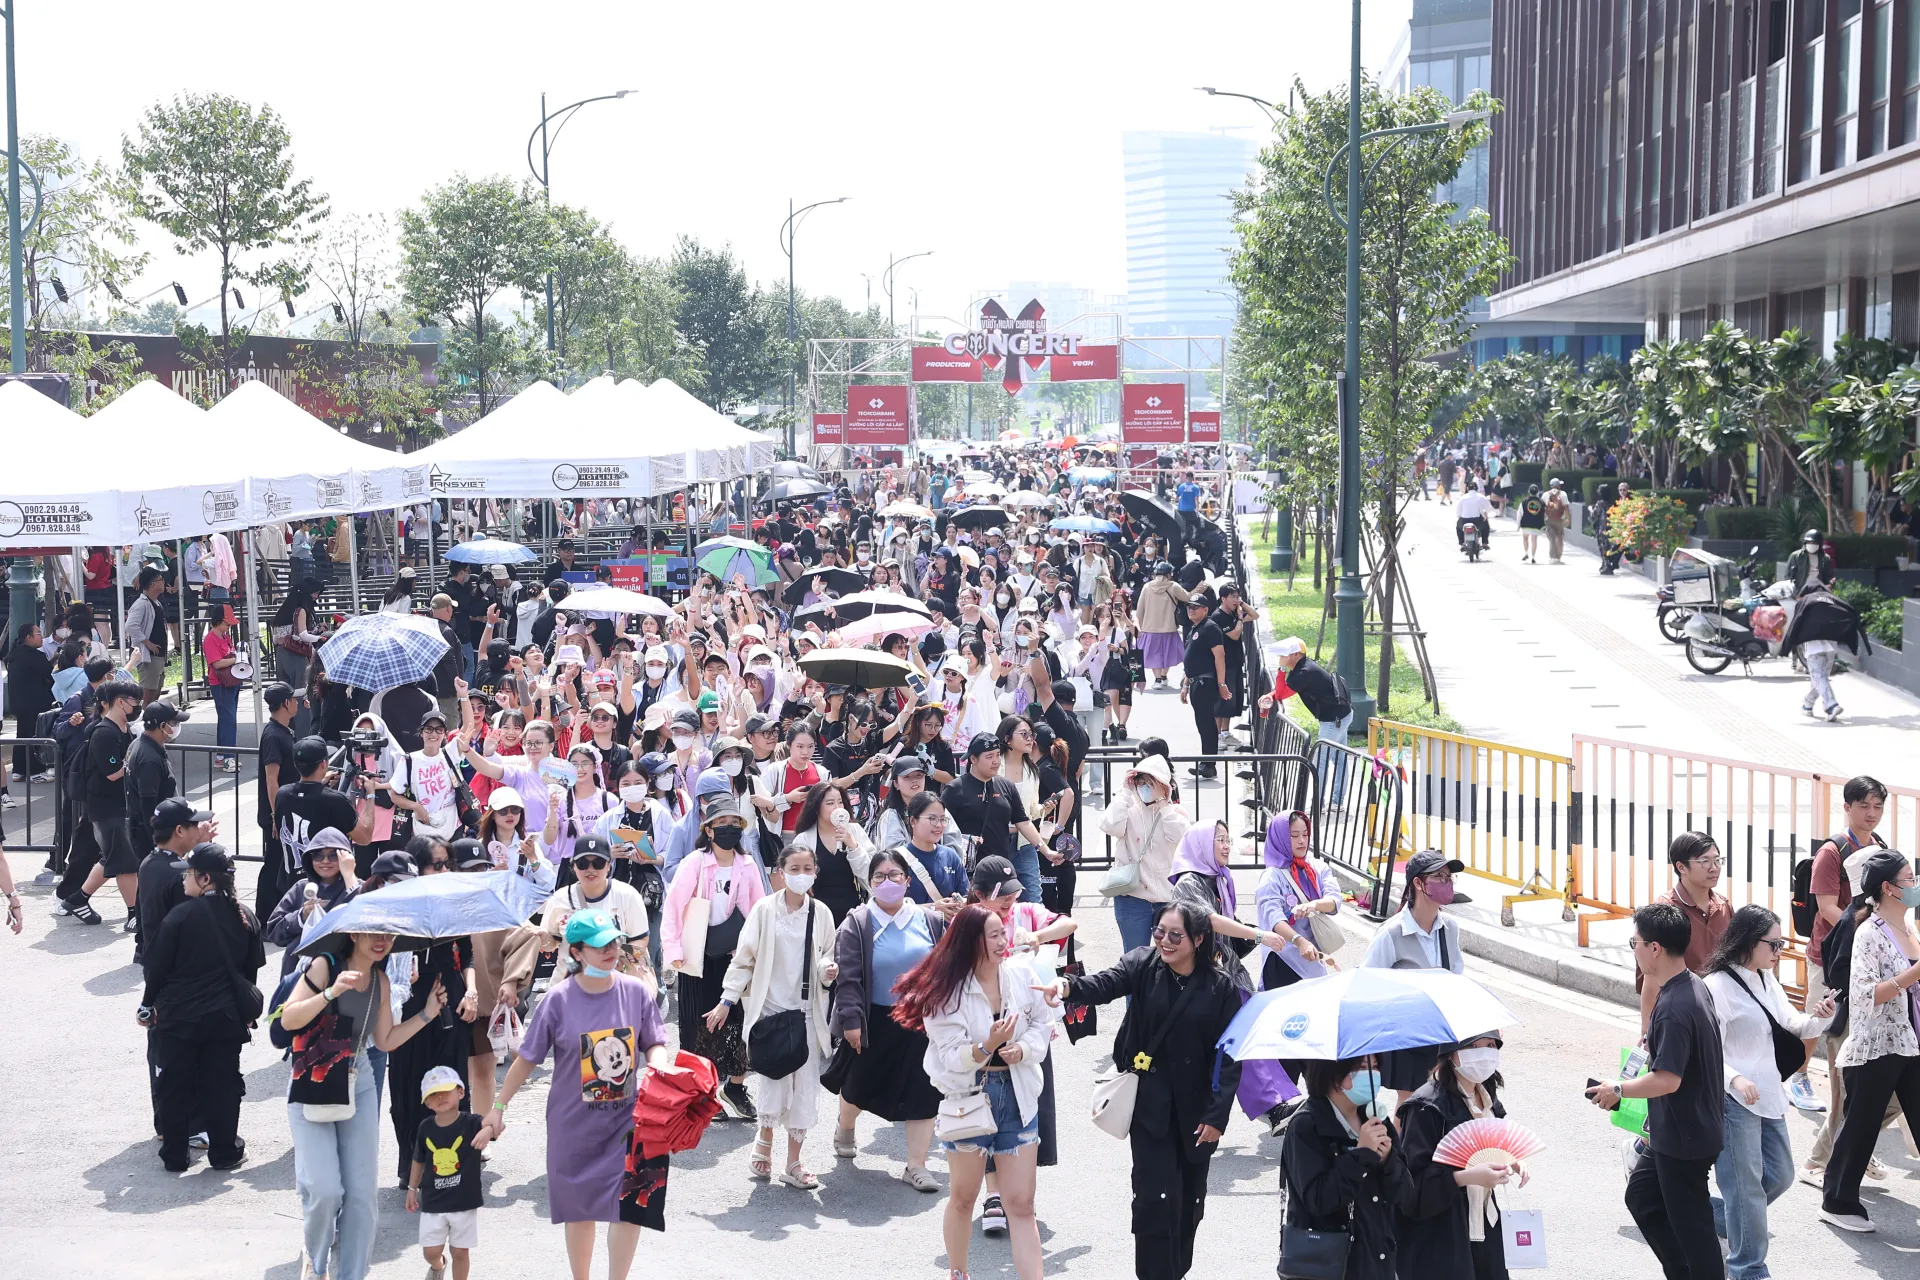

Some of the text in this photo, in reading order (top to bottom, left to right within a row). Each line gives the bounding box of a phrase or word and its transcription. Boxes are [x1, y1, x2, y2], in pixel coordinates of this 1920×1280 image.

[430, 475, 486, 487] FANSVIET
[25, 505, 80, 514] 0902.29.49.49
[26, 524, 81, 533] 0967.828.848
[587, 1102, 609, 1111] NICE
